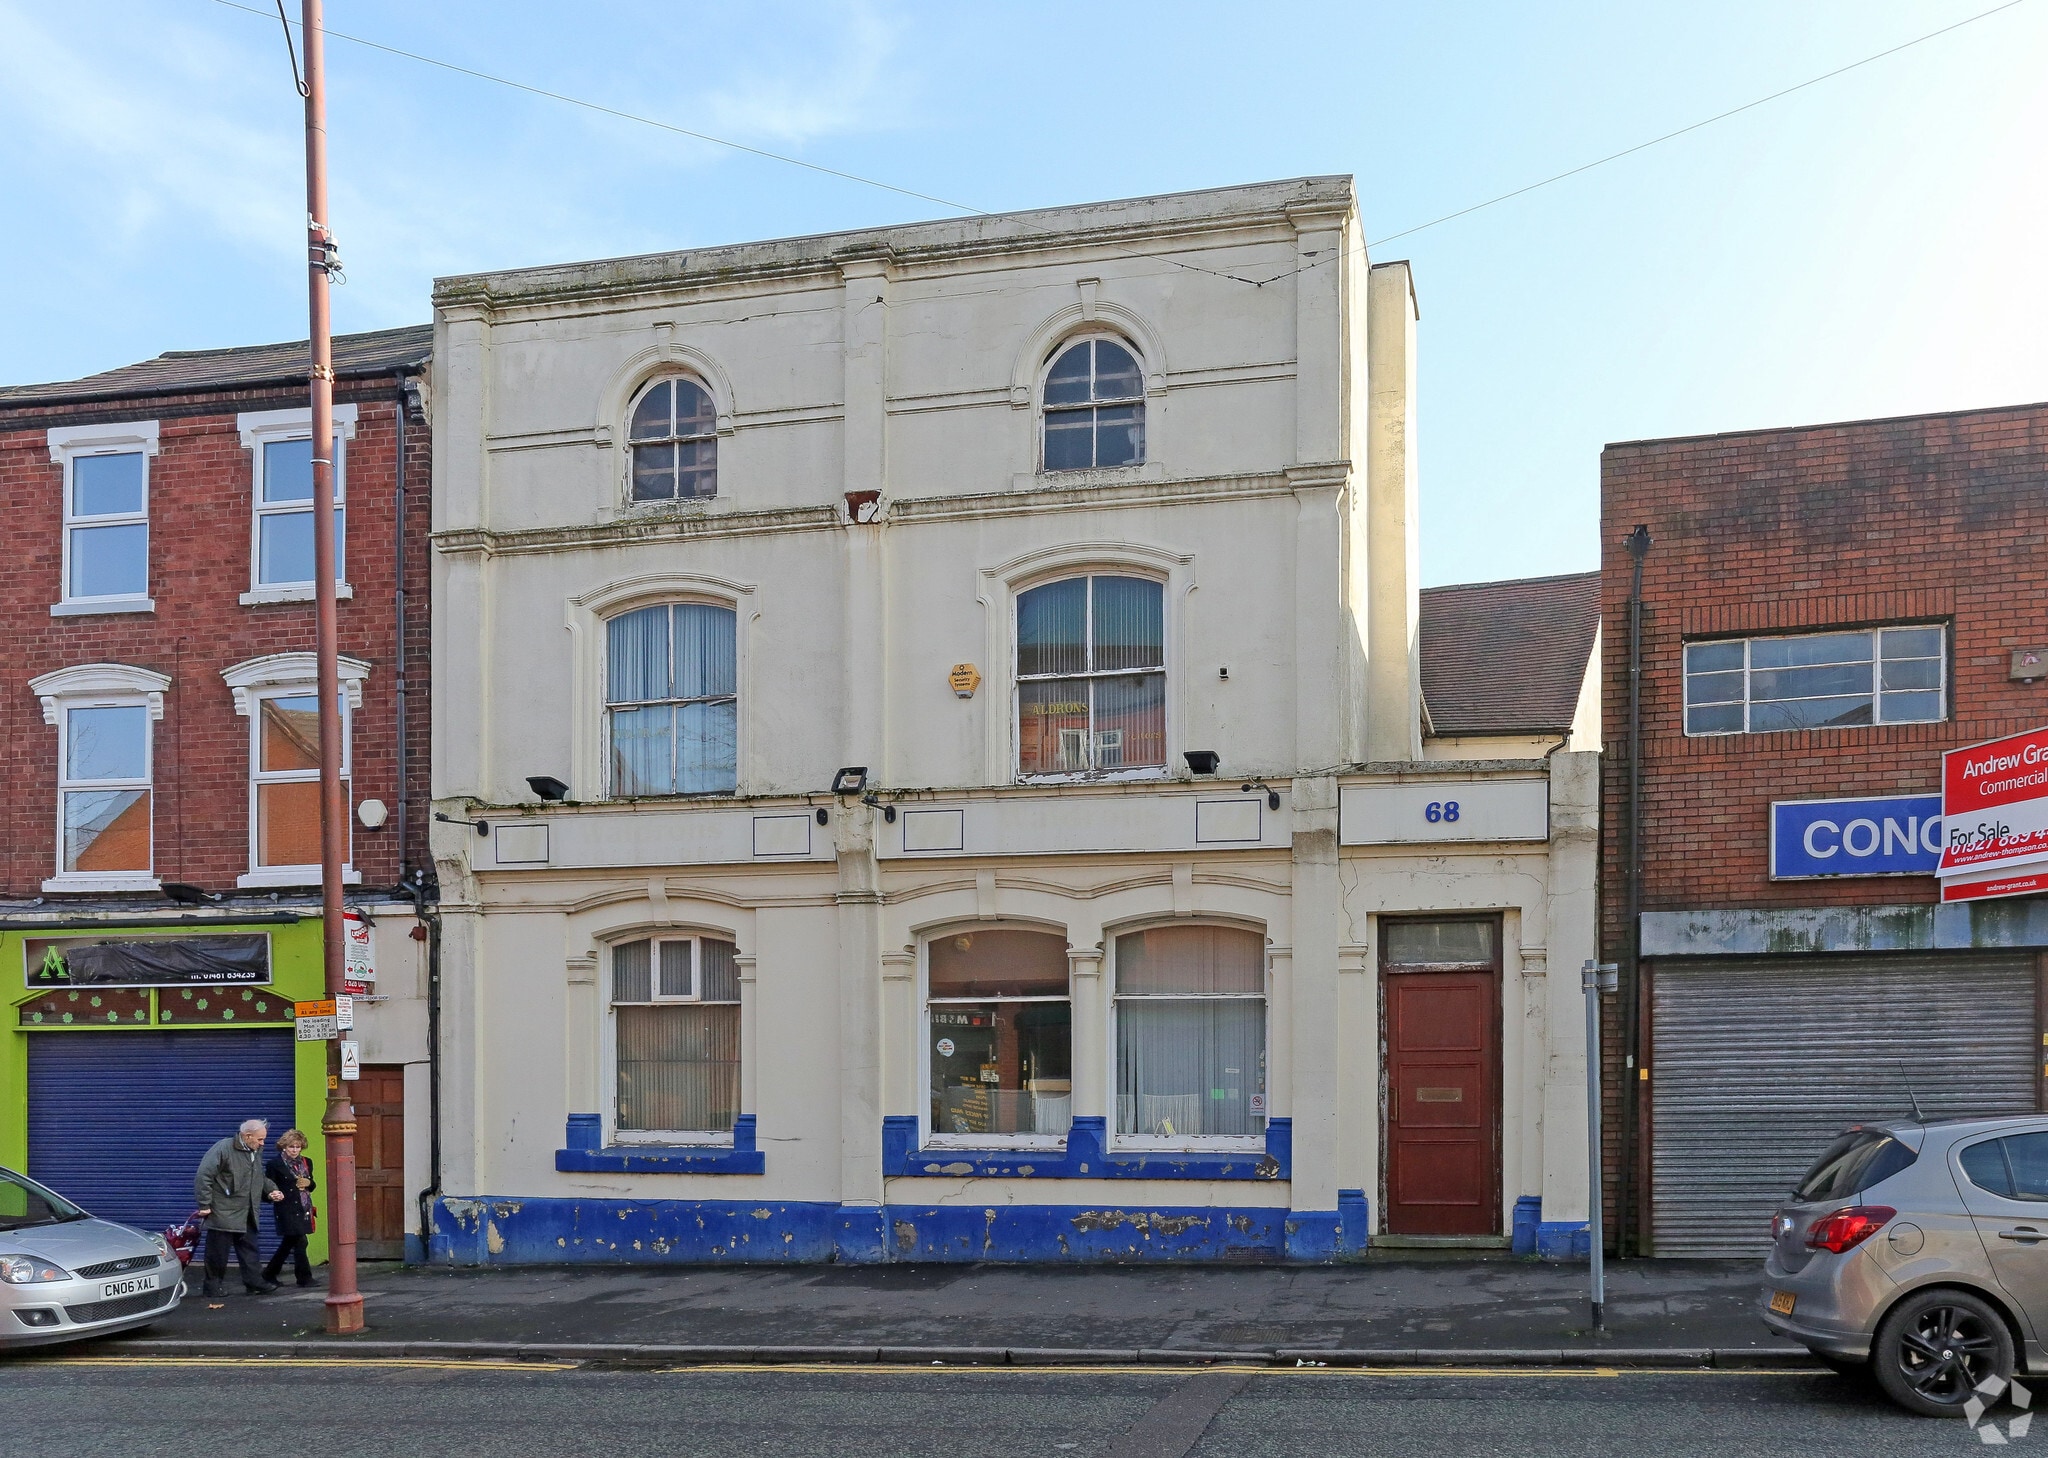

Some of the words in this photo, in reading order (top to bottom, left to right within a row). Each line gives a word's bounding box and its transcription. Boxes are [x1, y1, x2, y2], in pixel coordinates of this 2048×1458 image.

[1963, 753, 2022, 779] Andrew
[1980, 767, 2048, 796] Commercial
[1425, 801, 1460, 823] 68
[1950, 828, 1975, 847] For
[1977, 820, 2010, 843] Sale
[1986, 879, 2037, 892] andrew-grant.co.uk
[105, 1281, 134, 1297] CN06
[137, 1277, 154, 1291] XAL
